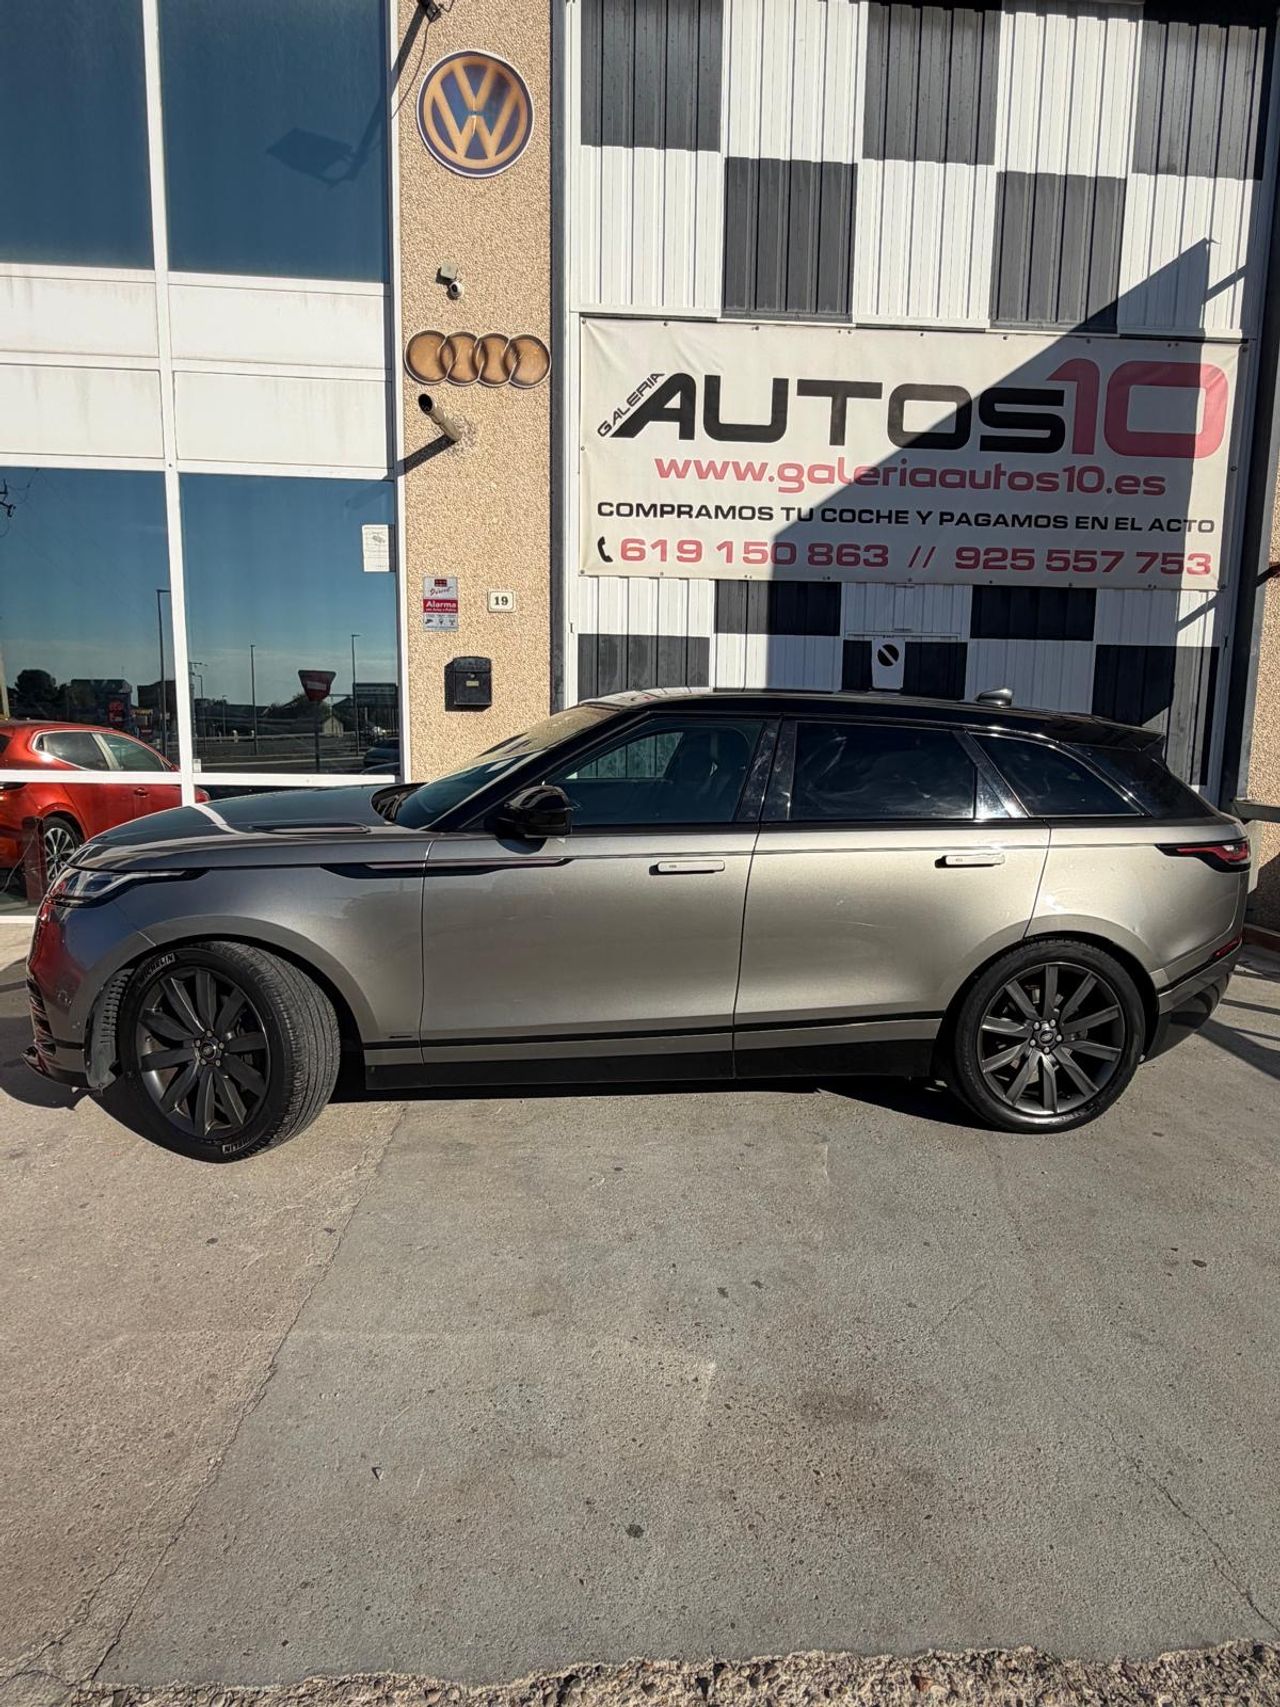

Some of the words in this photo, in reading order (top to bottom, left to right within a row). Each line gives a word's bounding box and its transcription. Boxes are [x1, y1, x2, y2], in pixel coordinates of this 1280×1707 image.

[597, 373, 665, 437] GALERIA
[654, 457, 1167, 495] www.galeriaautos10.es
[597, 502, 774, 521] COMPRAMOS
[781, 507, 814, 522] TU
[821, 508, 910, 525] COCHE
[916, 511, 933, 526] Y
[938, 511, 1068, 529] PAGAMOS
[1075, 516, 1108, 530] EN
[1114, 517, 1143, 531] EL
[1148, 518, 1215, 534] ACTO
[620, 538, 703, 563] 619
[716, 540, 797, 566] 150
[808, 542, 889, 568] 863
[955, 546, 1035, 571] 925
[1045, 549, 1124, 573] 557
[1135, 551, 1212, 576] 753
[425, 600, 457, 608] Alarma
[494, 596, 508, 606] 19
